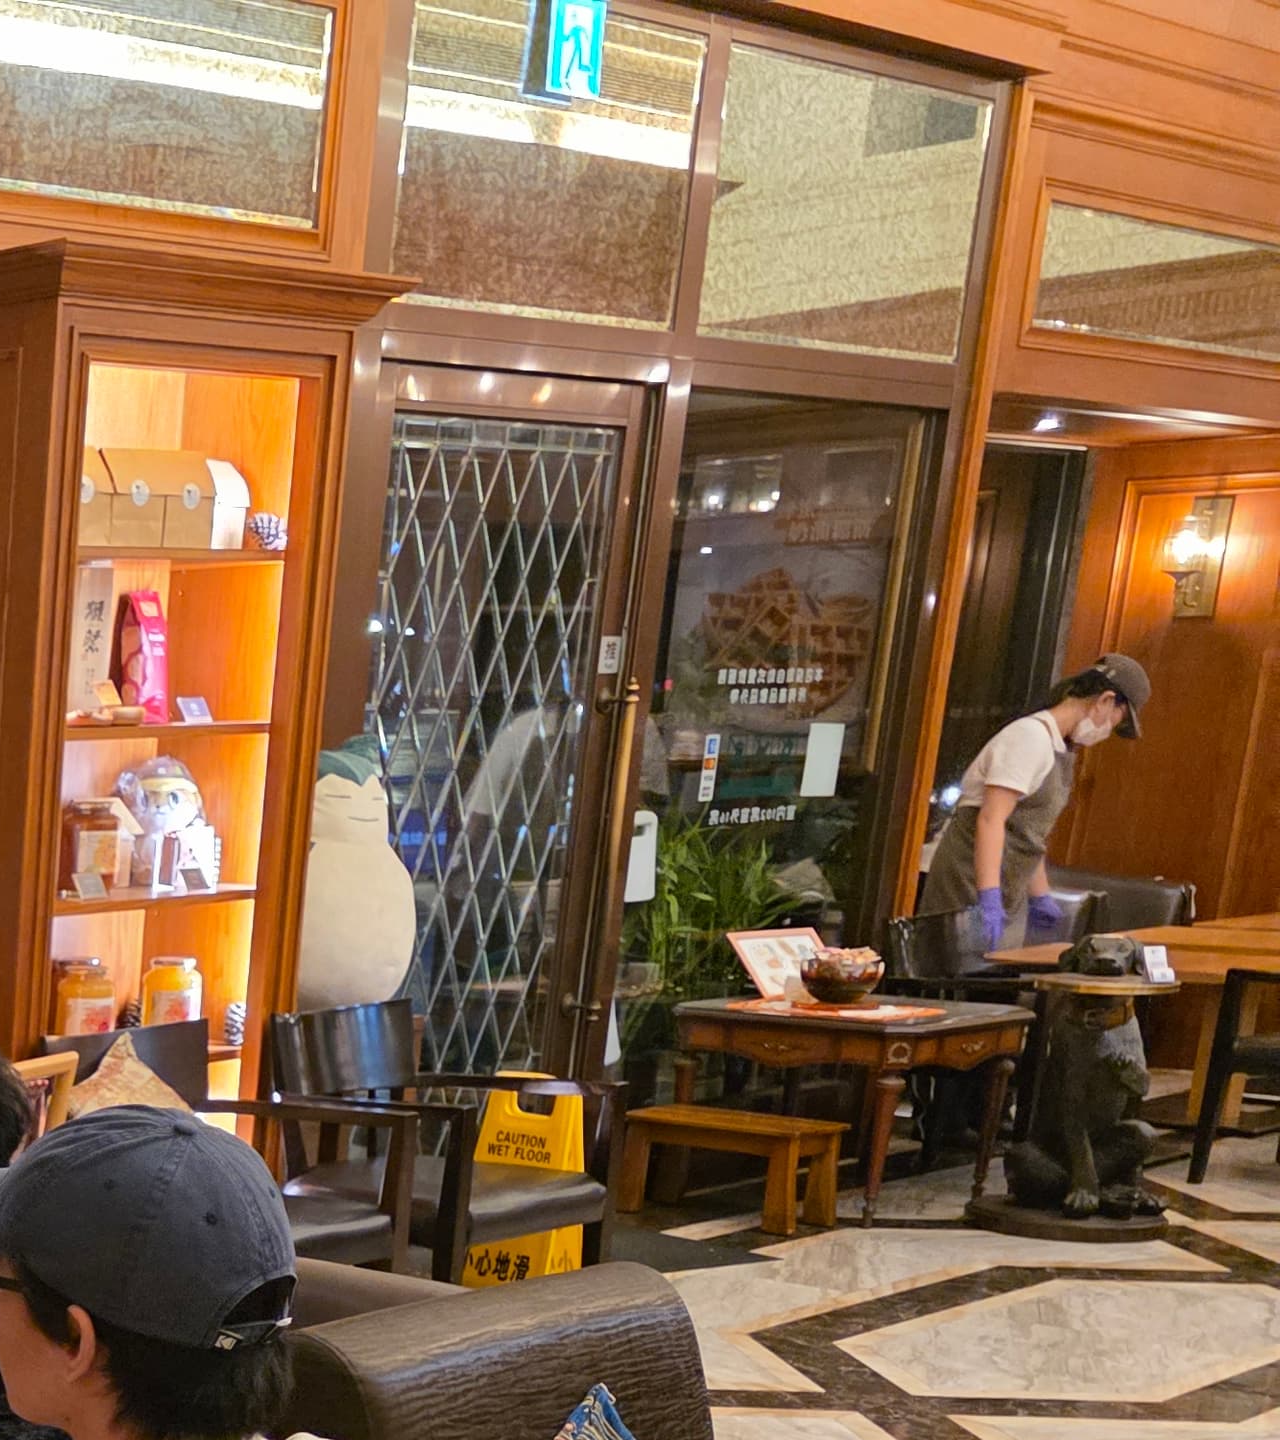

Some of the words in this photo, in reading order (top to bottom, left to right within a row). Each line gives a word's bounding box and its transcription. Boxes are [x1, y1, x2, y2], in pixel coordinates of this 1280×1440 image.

[496, 1130, 546, 1149] CAUTION
[488, 1142, 509, 1157] WET
[514, 1147, 551, 1164] FLOOR
